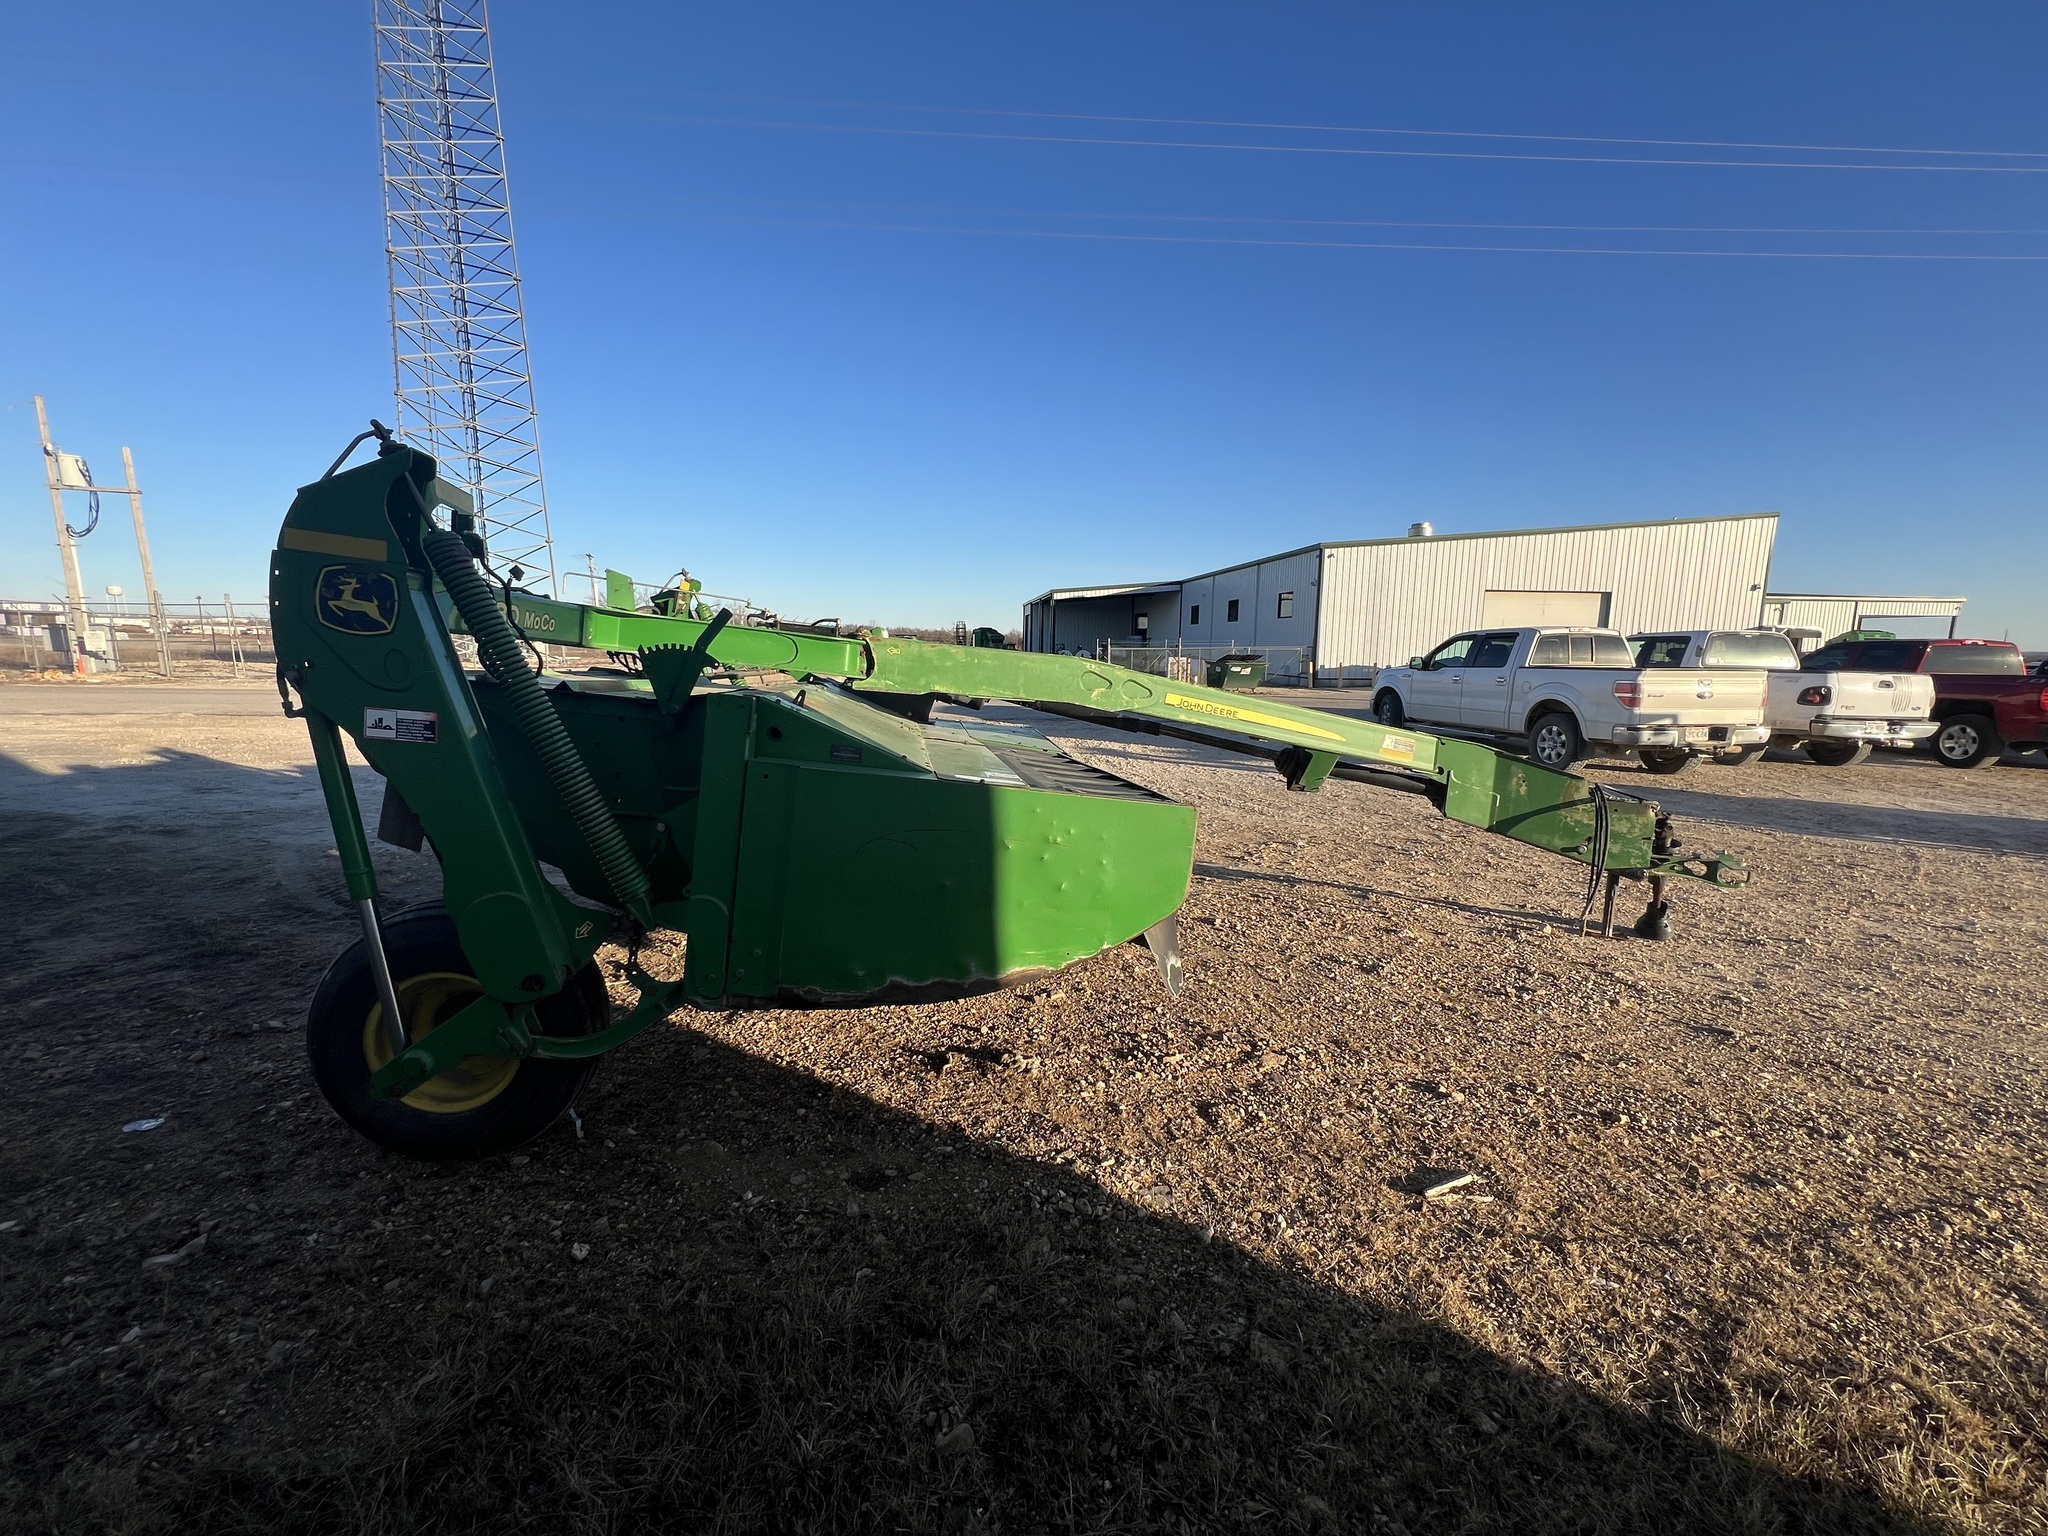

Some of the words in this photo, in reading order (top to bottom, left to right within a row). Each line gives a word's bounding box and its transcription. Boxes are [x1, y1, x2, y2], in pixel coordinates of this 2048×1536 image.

[524, 611, 556, 631] MoCo
[1177, 698, 1204, 711] JOHN
[1205, 703, 1239, 718] DEERE
